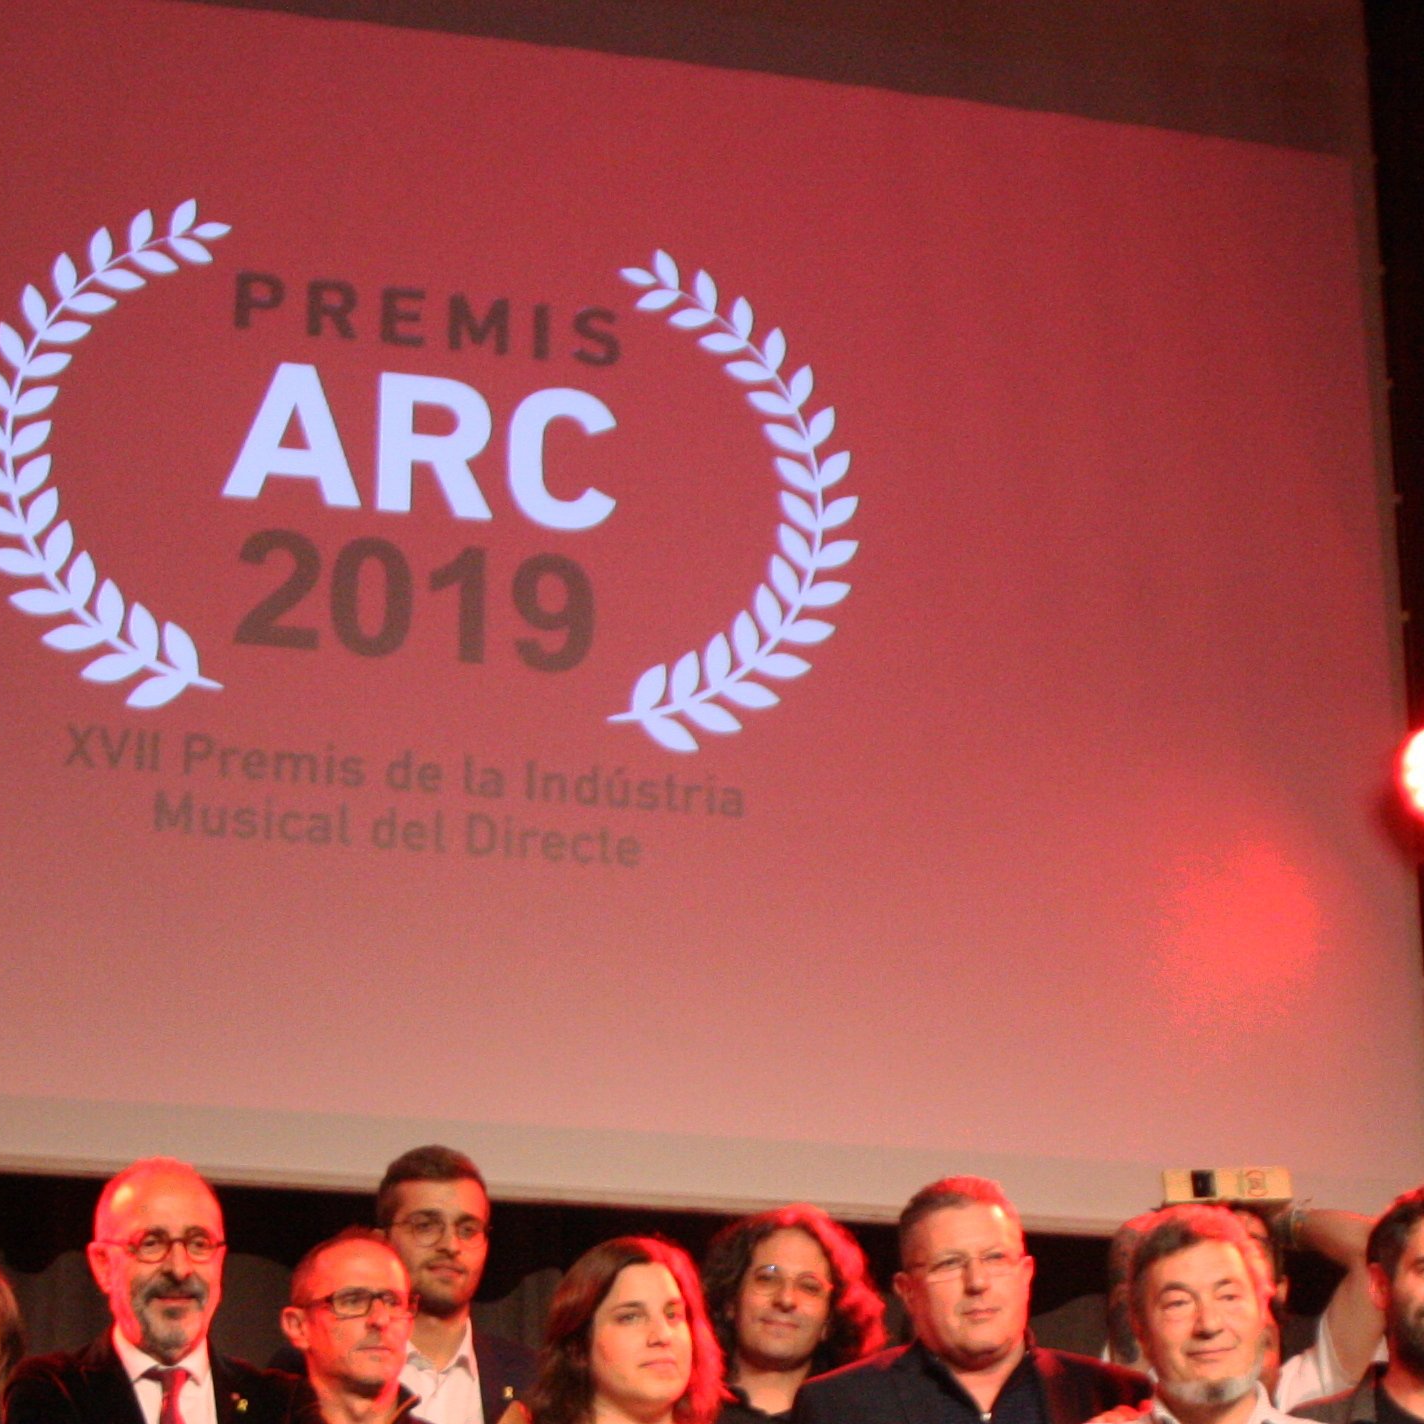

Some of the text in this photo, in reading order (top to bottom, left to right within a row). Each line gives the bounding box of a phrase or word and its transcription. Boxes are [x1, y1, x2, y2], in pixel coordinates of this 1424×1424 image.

[233, 271, 622, 367] PREMIS
[220, 361, 618, 532] ARC
[231, 528, 597, 673] 2019
[63, 722, 746, 818] XVII Premis de la Indústria
[152, 790, 643, 868] Musical del Directe
